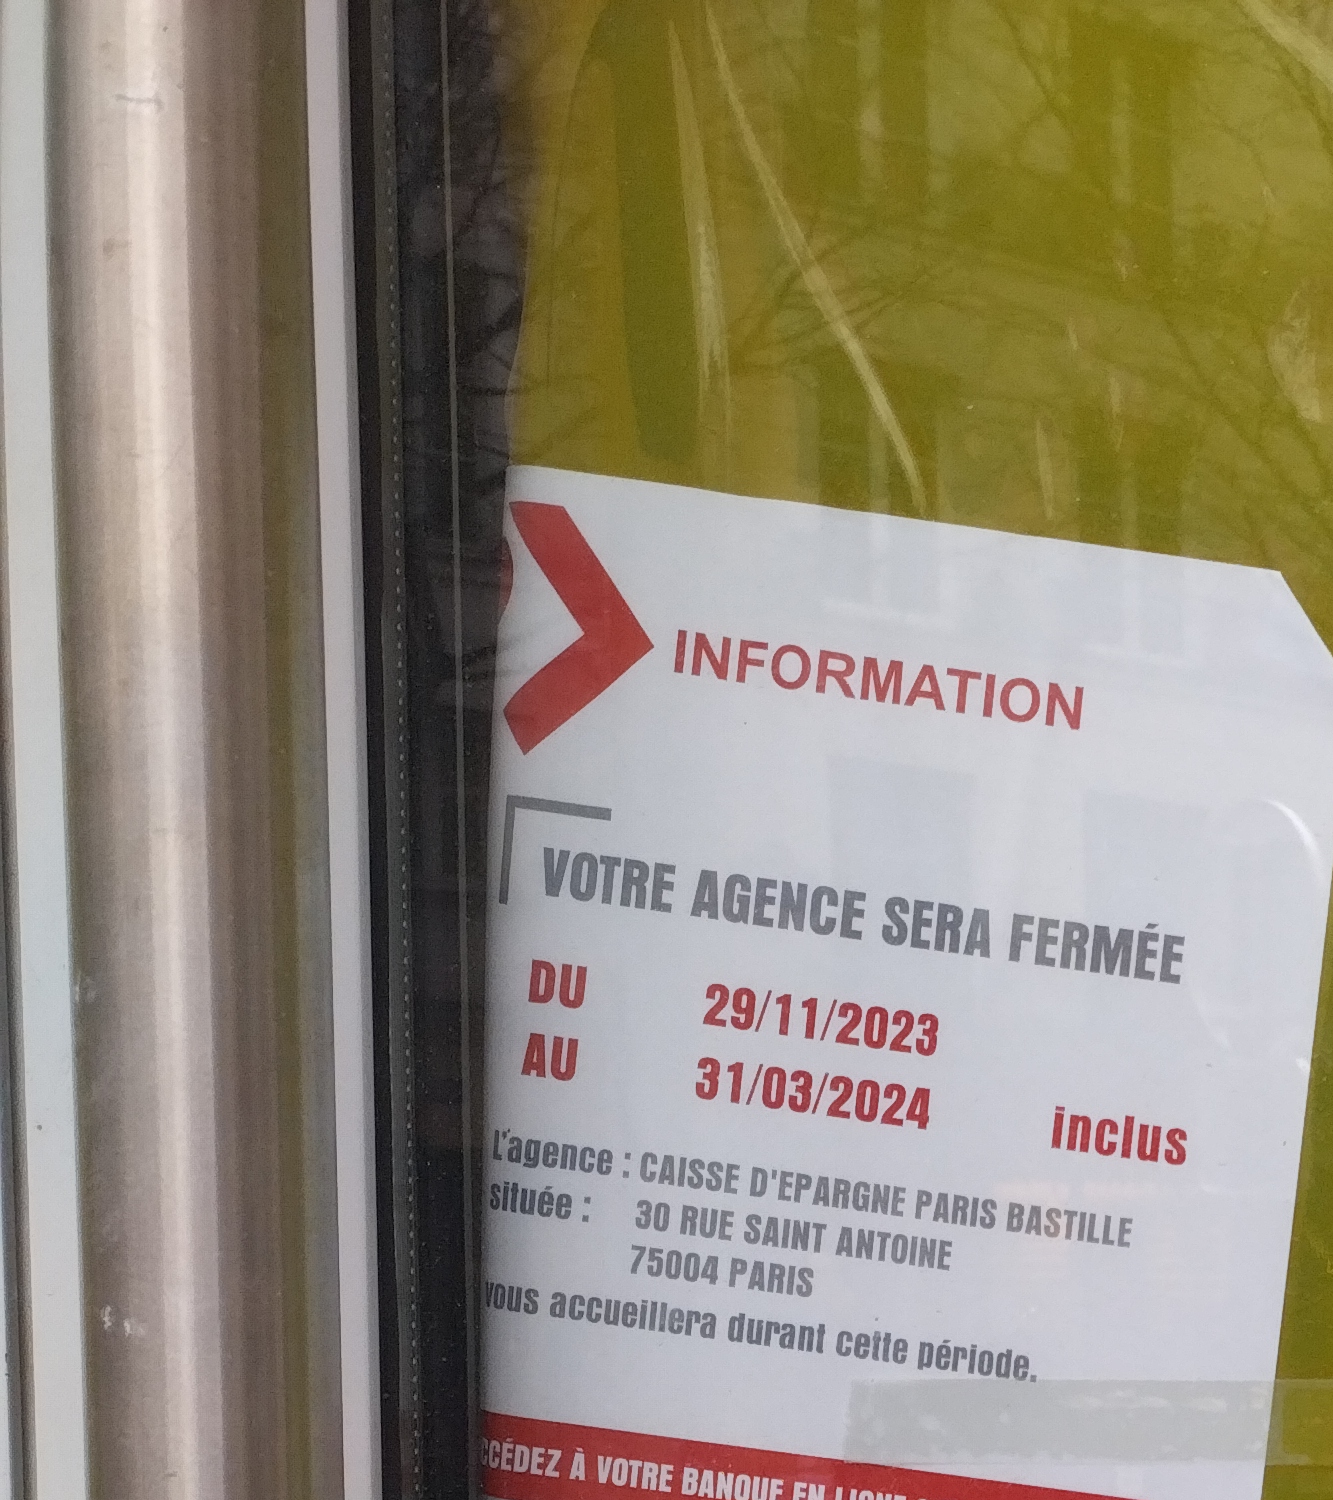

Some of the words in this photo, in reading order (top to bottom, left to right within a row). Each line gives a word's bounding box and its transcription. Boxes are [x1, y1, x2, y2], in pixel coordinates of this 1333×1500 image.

[673, 629, 1085, 731] INFORMATION
[543, 846, 677, 914] VOTRE
[690, 869, 867, 941] AGENCE
[881, 896, 991, 959] SERA
[1008, 912, 1186, 985] FERMÉE
[527, 958, 588, 1009] DU
[702, 983, 939, 1057] 29/11/2023
[520, 1032, 579, 1082] AU
[695, 1056, 931, 1131] 31/03/2024
[1051, 1105, 1188, 1166] inclus
[488, 1180, 573, 1220] située
[635, 1199, 671, 1233] 30
[679, 1204, 735, 1242] RUE
[743, 1213, 828, 1254] SAINT
[835, 1225, 953, 1271] ANTOINE
[490, 1128, 615, 1176] L'agence
[639, 1151, 741, 1195] CAISSE
[749, 1166, 907, 1217] D'EPARGNE
[914, 1189, 998, 1230] PARIS
[1006, 1201, 1134, 1248] BASTILLE
[630, 1243, 719, 1286] 75004
[728, 1257, 814, 1298] PARIS
[485, 1280, 540, 1315] vous
[549, 1291, 717, 1340] accueillera
[727, 1312, 826, 1355] durant
[835, 1330, 909, 1365] cette
[916, 1339, 1037, 1383] période.
[480, 1437, 562, 1478] CCÉDEZ
[569, 1447, 586, 1481] À
[597, 1455, 674, 1493] VOTRE
